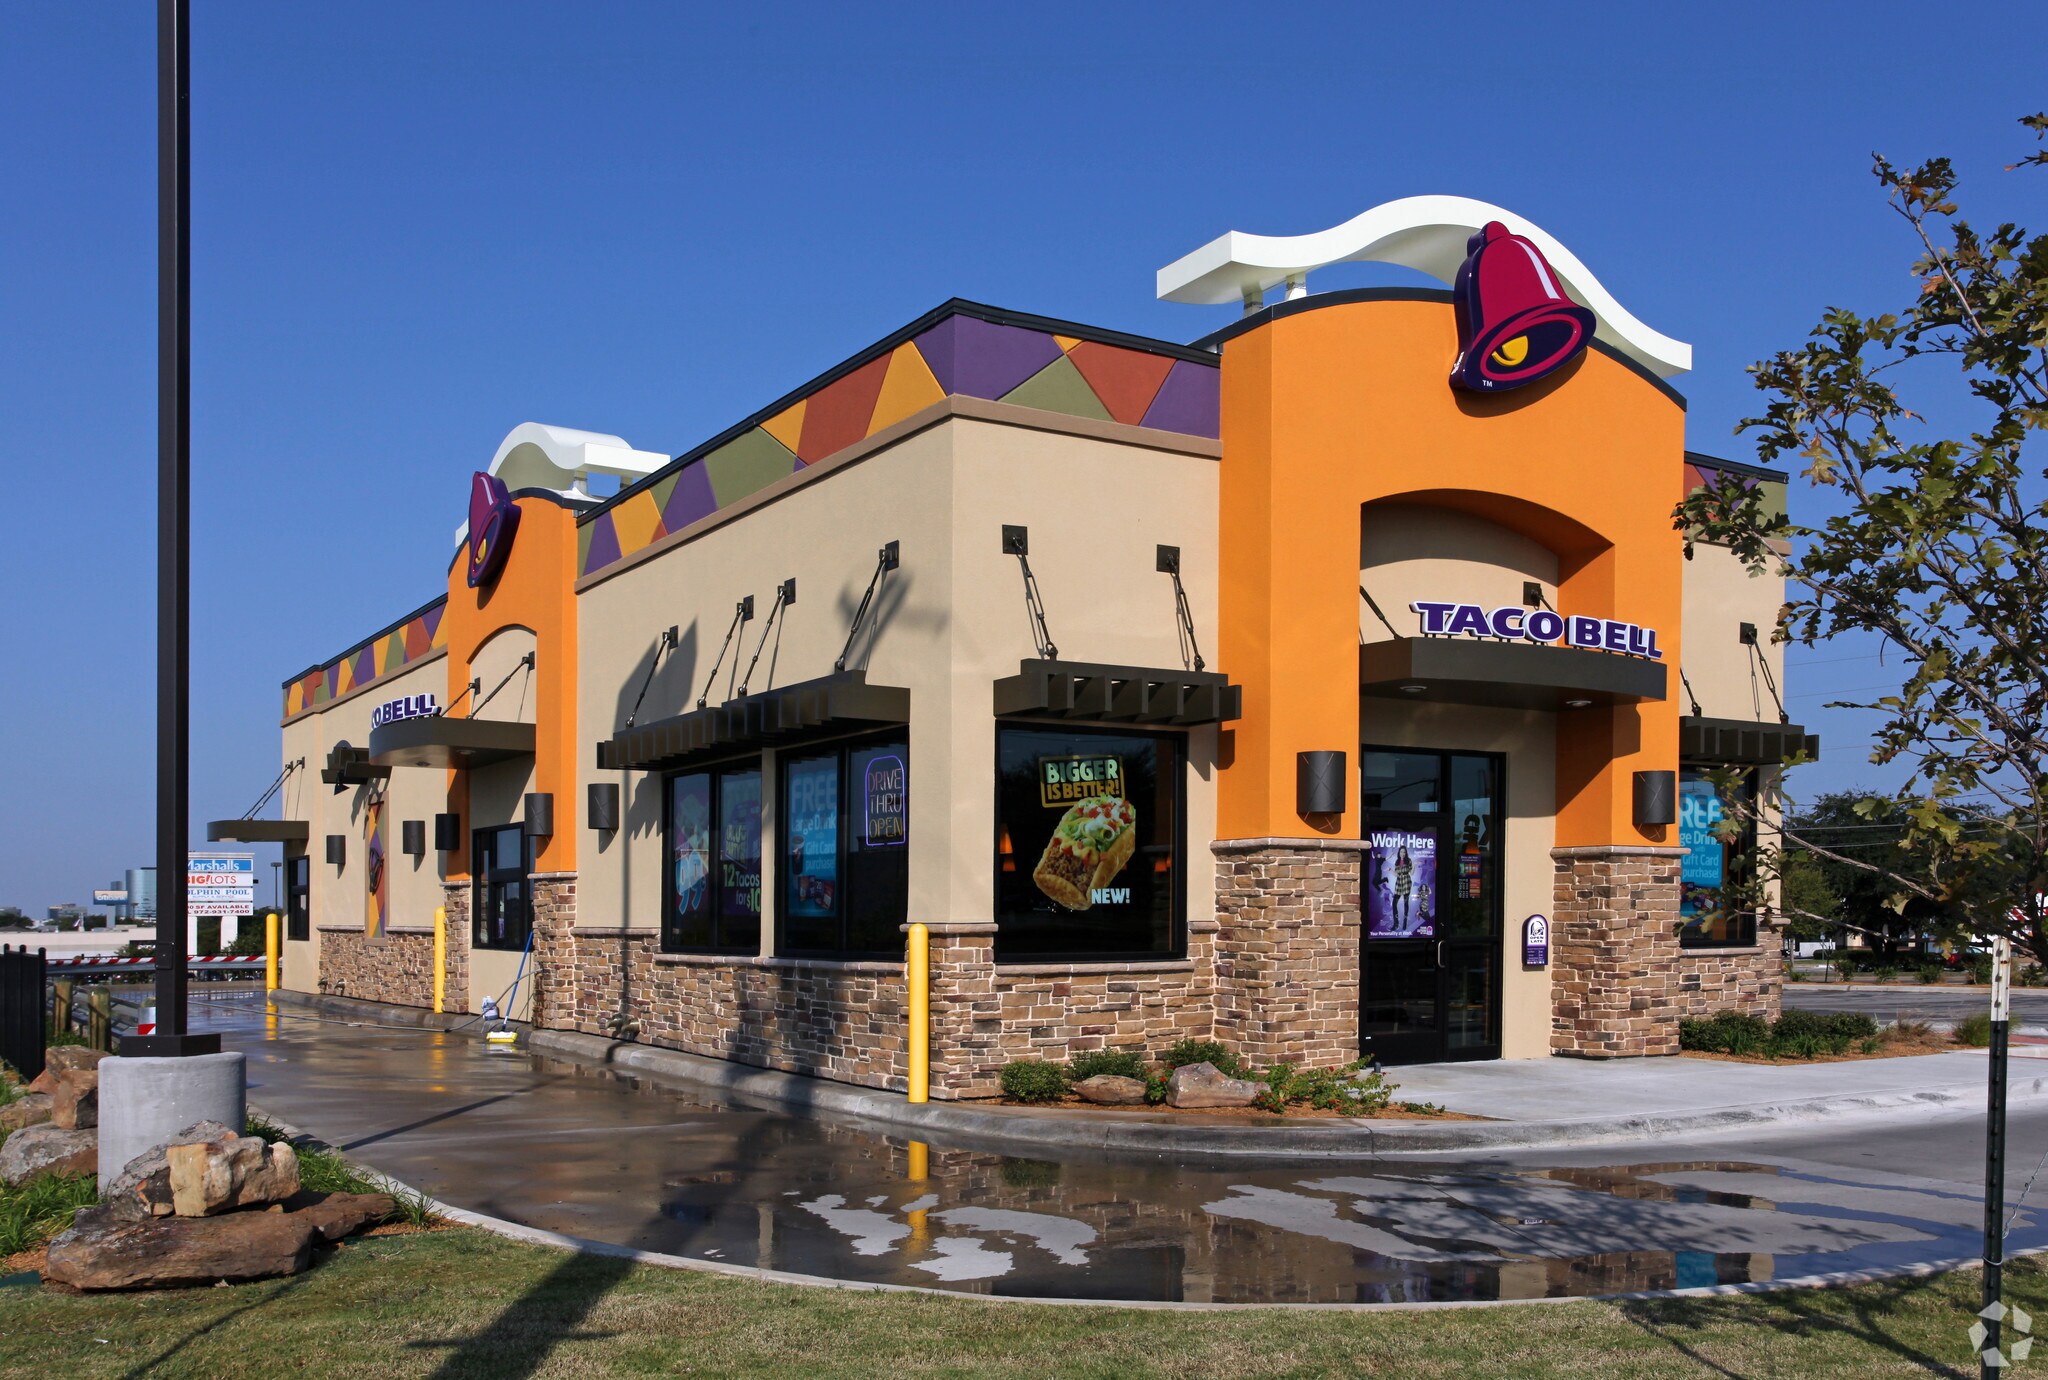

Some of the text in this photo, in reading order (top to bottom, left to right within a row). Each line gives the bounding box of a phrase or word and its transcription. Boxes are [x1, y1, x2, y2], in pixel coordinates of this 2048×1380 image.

[1482, 379, 1493, 388] TM
[1409, 601, 1662, 661] TACO BELL
[382, 693, 442, 724] BELL
[868, 768, 902, 793] DRIVE
[1045, 759, 1119, 784] BIGGER
[791, 772, 837, 813] FREE
[1047, 779, 1120, 800] IS BETTER!
[870, 793, 903, 814] THRU
[869, 816, 903, 838] OPEN
[1371, 833, 1434, 849] Work Here
[1693, 831, 1720, 846] Drin
[1682, 854, 1719, 867] Gift Card
[723, 863, 760, 887] 12 Tacos
[1682, 867, 1719, 879] purchase!
[736, 889, 746, 905] for
[1091, 888, 1130, 904] NEW!
